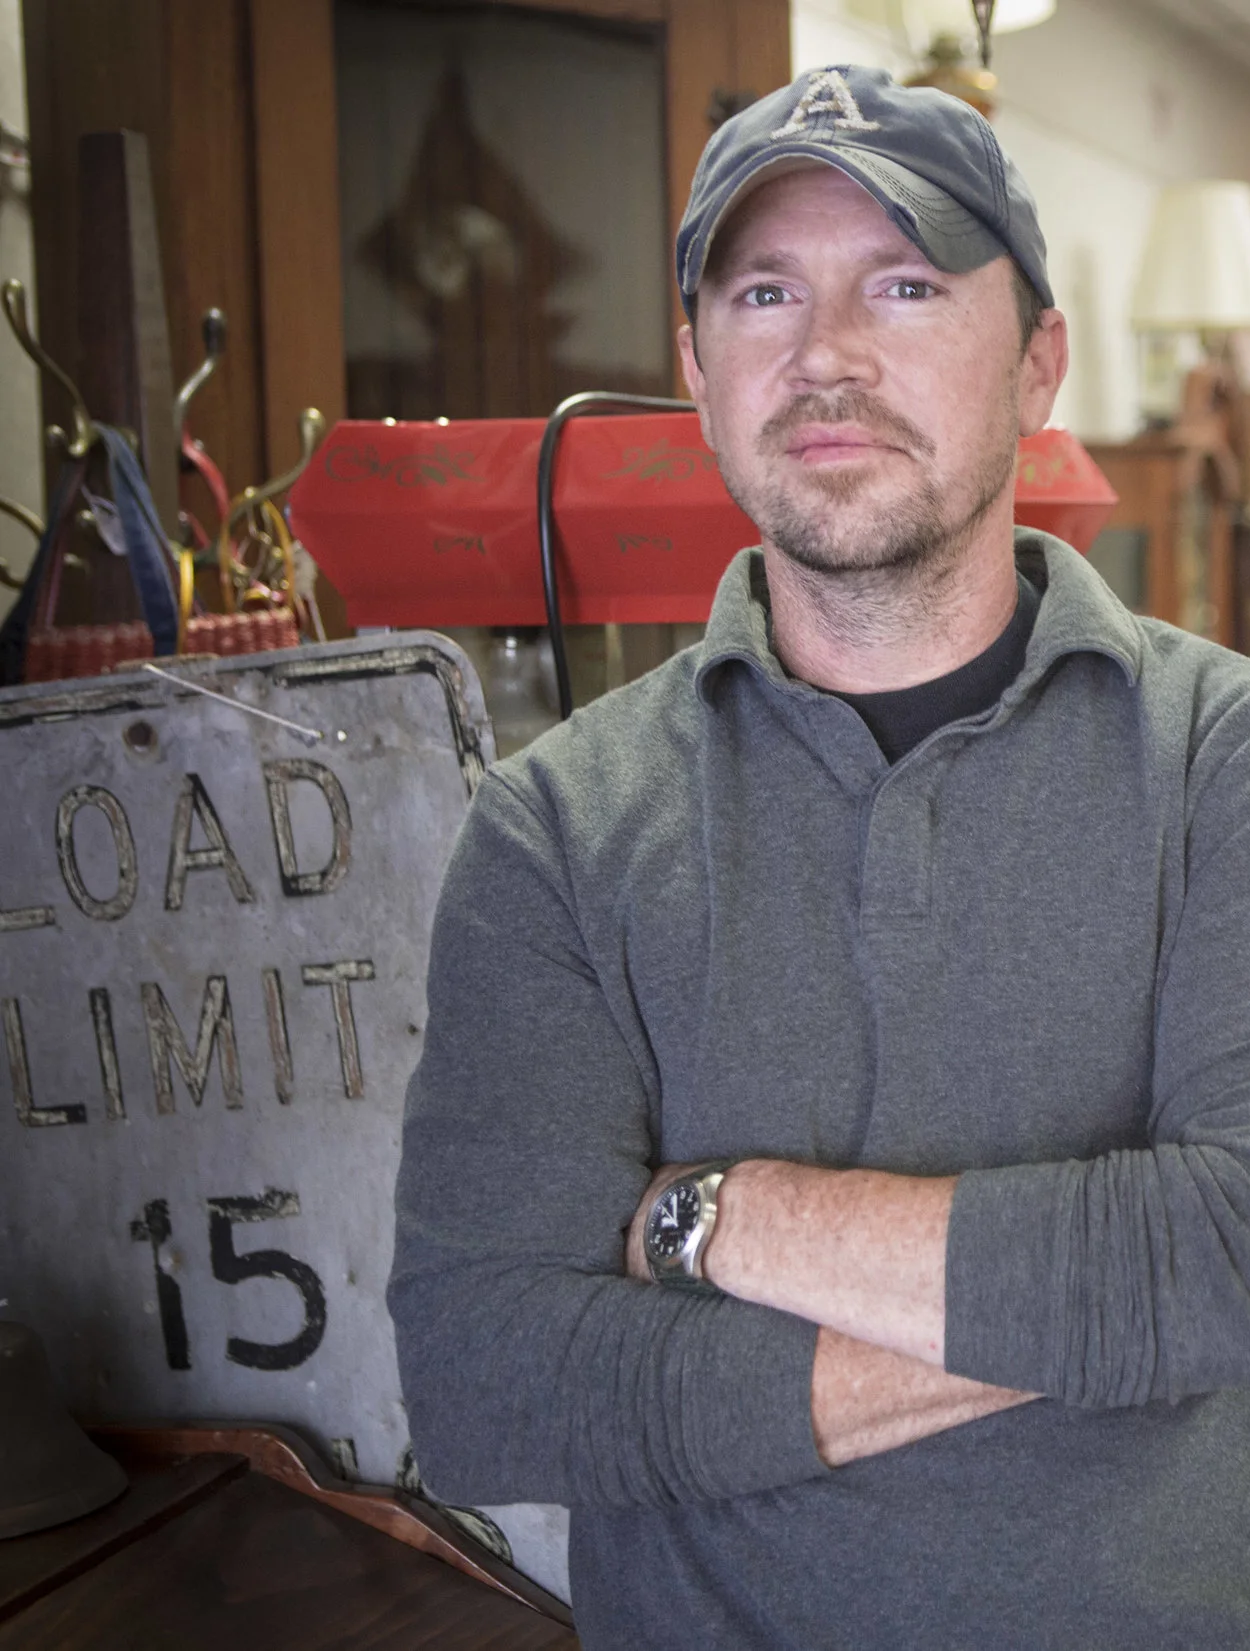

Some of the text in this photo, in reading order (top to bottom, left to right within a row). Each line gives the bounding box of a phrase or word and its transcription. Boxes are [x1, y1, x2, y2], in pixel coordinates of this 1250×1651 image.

[770, 70, 880, 139] A
[4, 960, 375, 1127] LIMIT
[129, 1186, 328, 1372] 15
